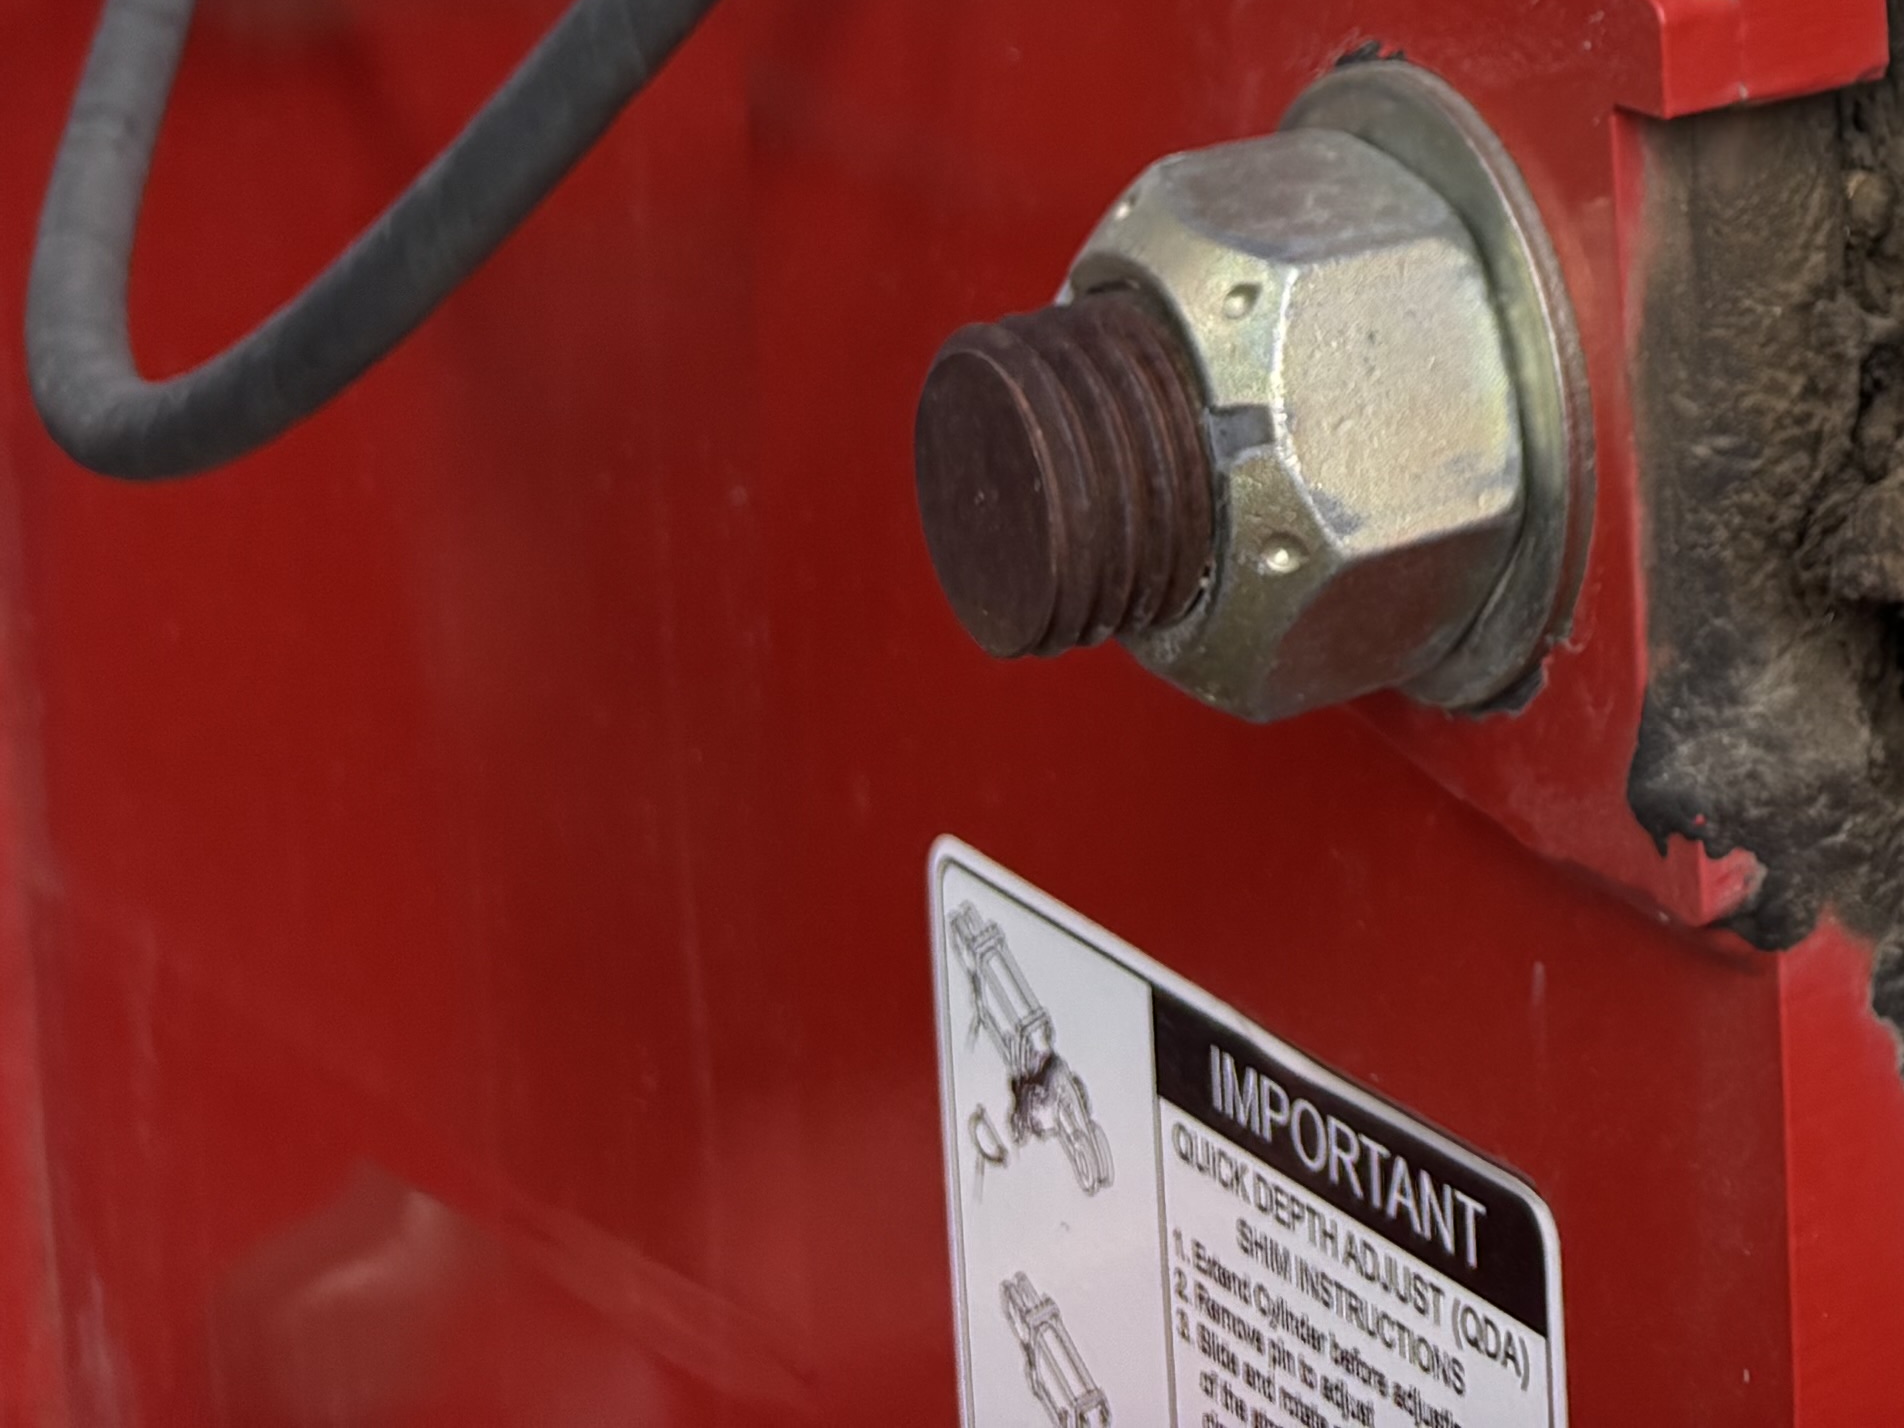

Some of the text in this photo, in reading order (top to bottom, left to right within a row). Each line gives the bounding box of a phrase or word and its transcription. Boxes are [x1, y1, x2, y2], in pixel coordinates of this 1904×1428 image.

[1209, 1044, 1487, 1269] IMPORTANT
[1172, 1121, 1530, 1392] QUICK DEPTH ADJUST (QDA)
[1191, 1238, 1252, 1307] Extend
[1253, 1282, 1328, 1353] Cylinder
[1329, 1330, 1389, 1398] before
[1194, 1279, 1265, 1356] Remove
[1268, 1337, 1297, 1378] pin
[1298, 1352, 1318, 1390] to
[1236, 1218, 1465, 1396] SHIM INSTRUCTIONS
[1197, 1322, 1240, 1379] Slide
[1242, 1360, 1276, 1405] and
[1220, 1380, 1248, 1423] the
